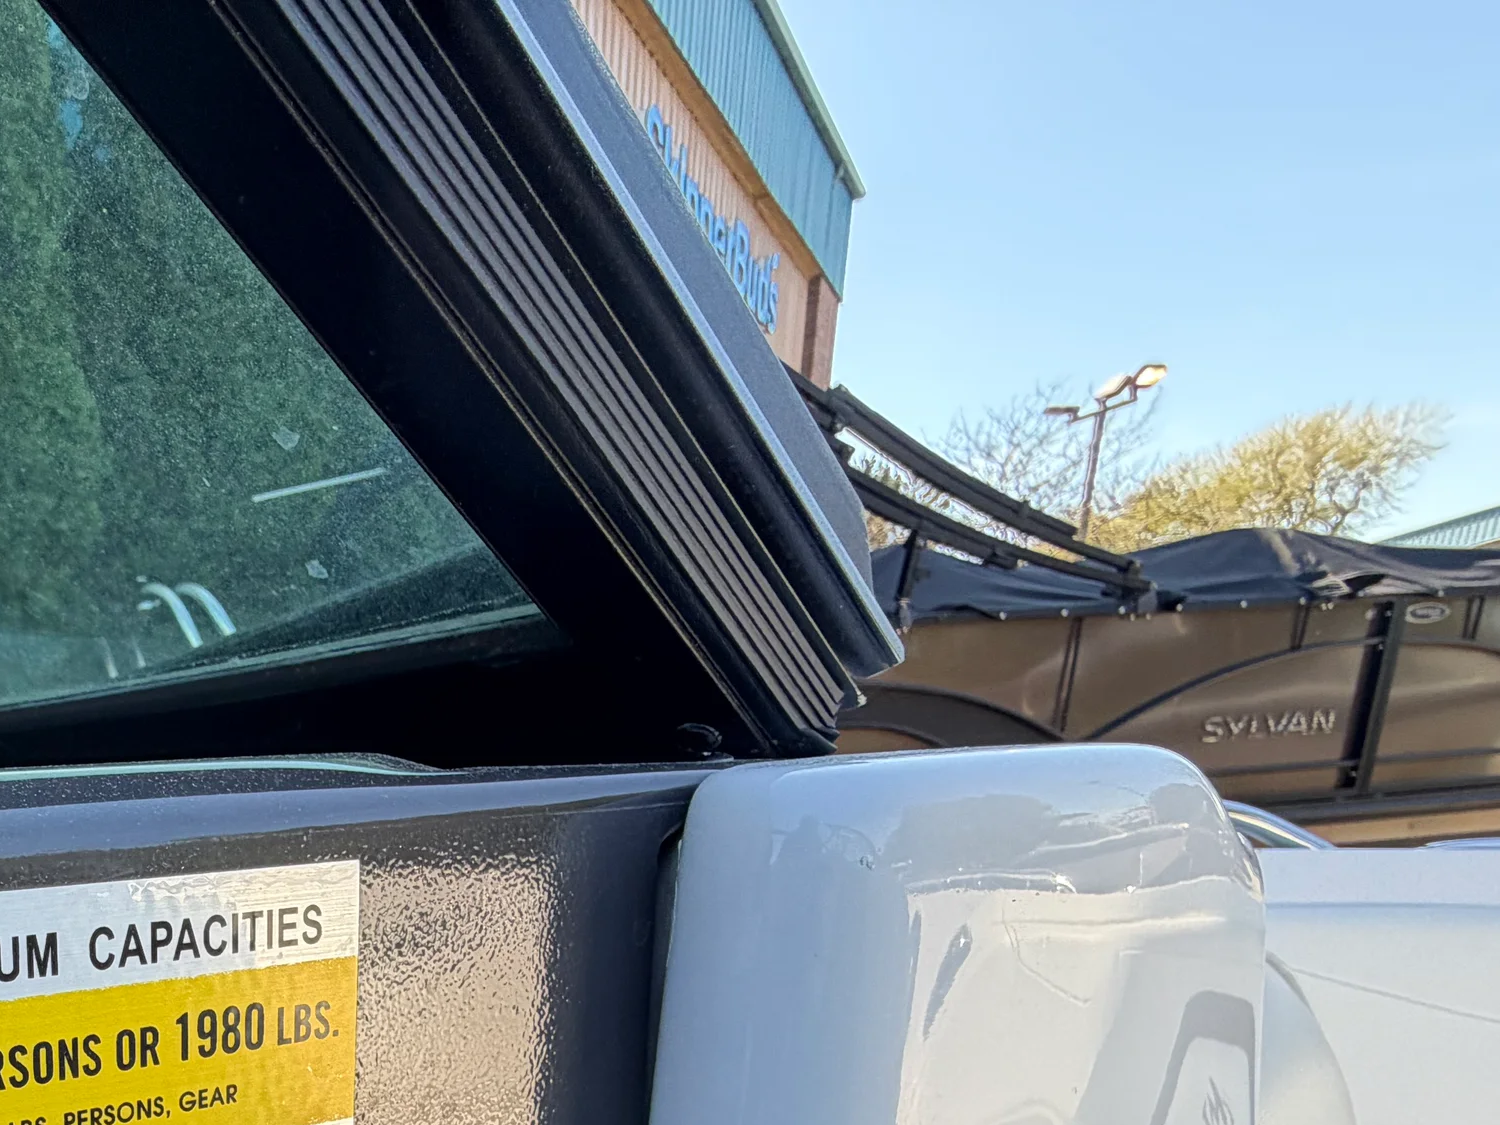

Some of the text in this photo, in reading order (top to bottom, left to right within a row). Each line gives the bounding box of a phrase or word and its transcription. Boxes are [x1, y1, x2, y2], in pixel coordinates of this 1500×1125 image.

[1202, 708, 1336, 743] SYLVAN
[89, 904, 323, 971] CAPACITIES
[116, 1026, 160, 1071] OR
[175, 1002, 265, 1061] 1980
[277, 1000, 339, 1046] LBS.
[179, 1084, 238, 1112] GEAR
